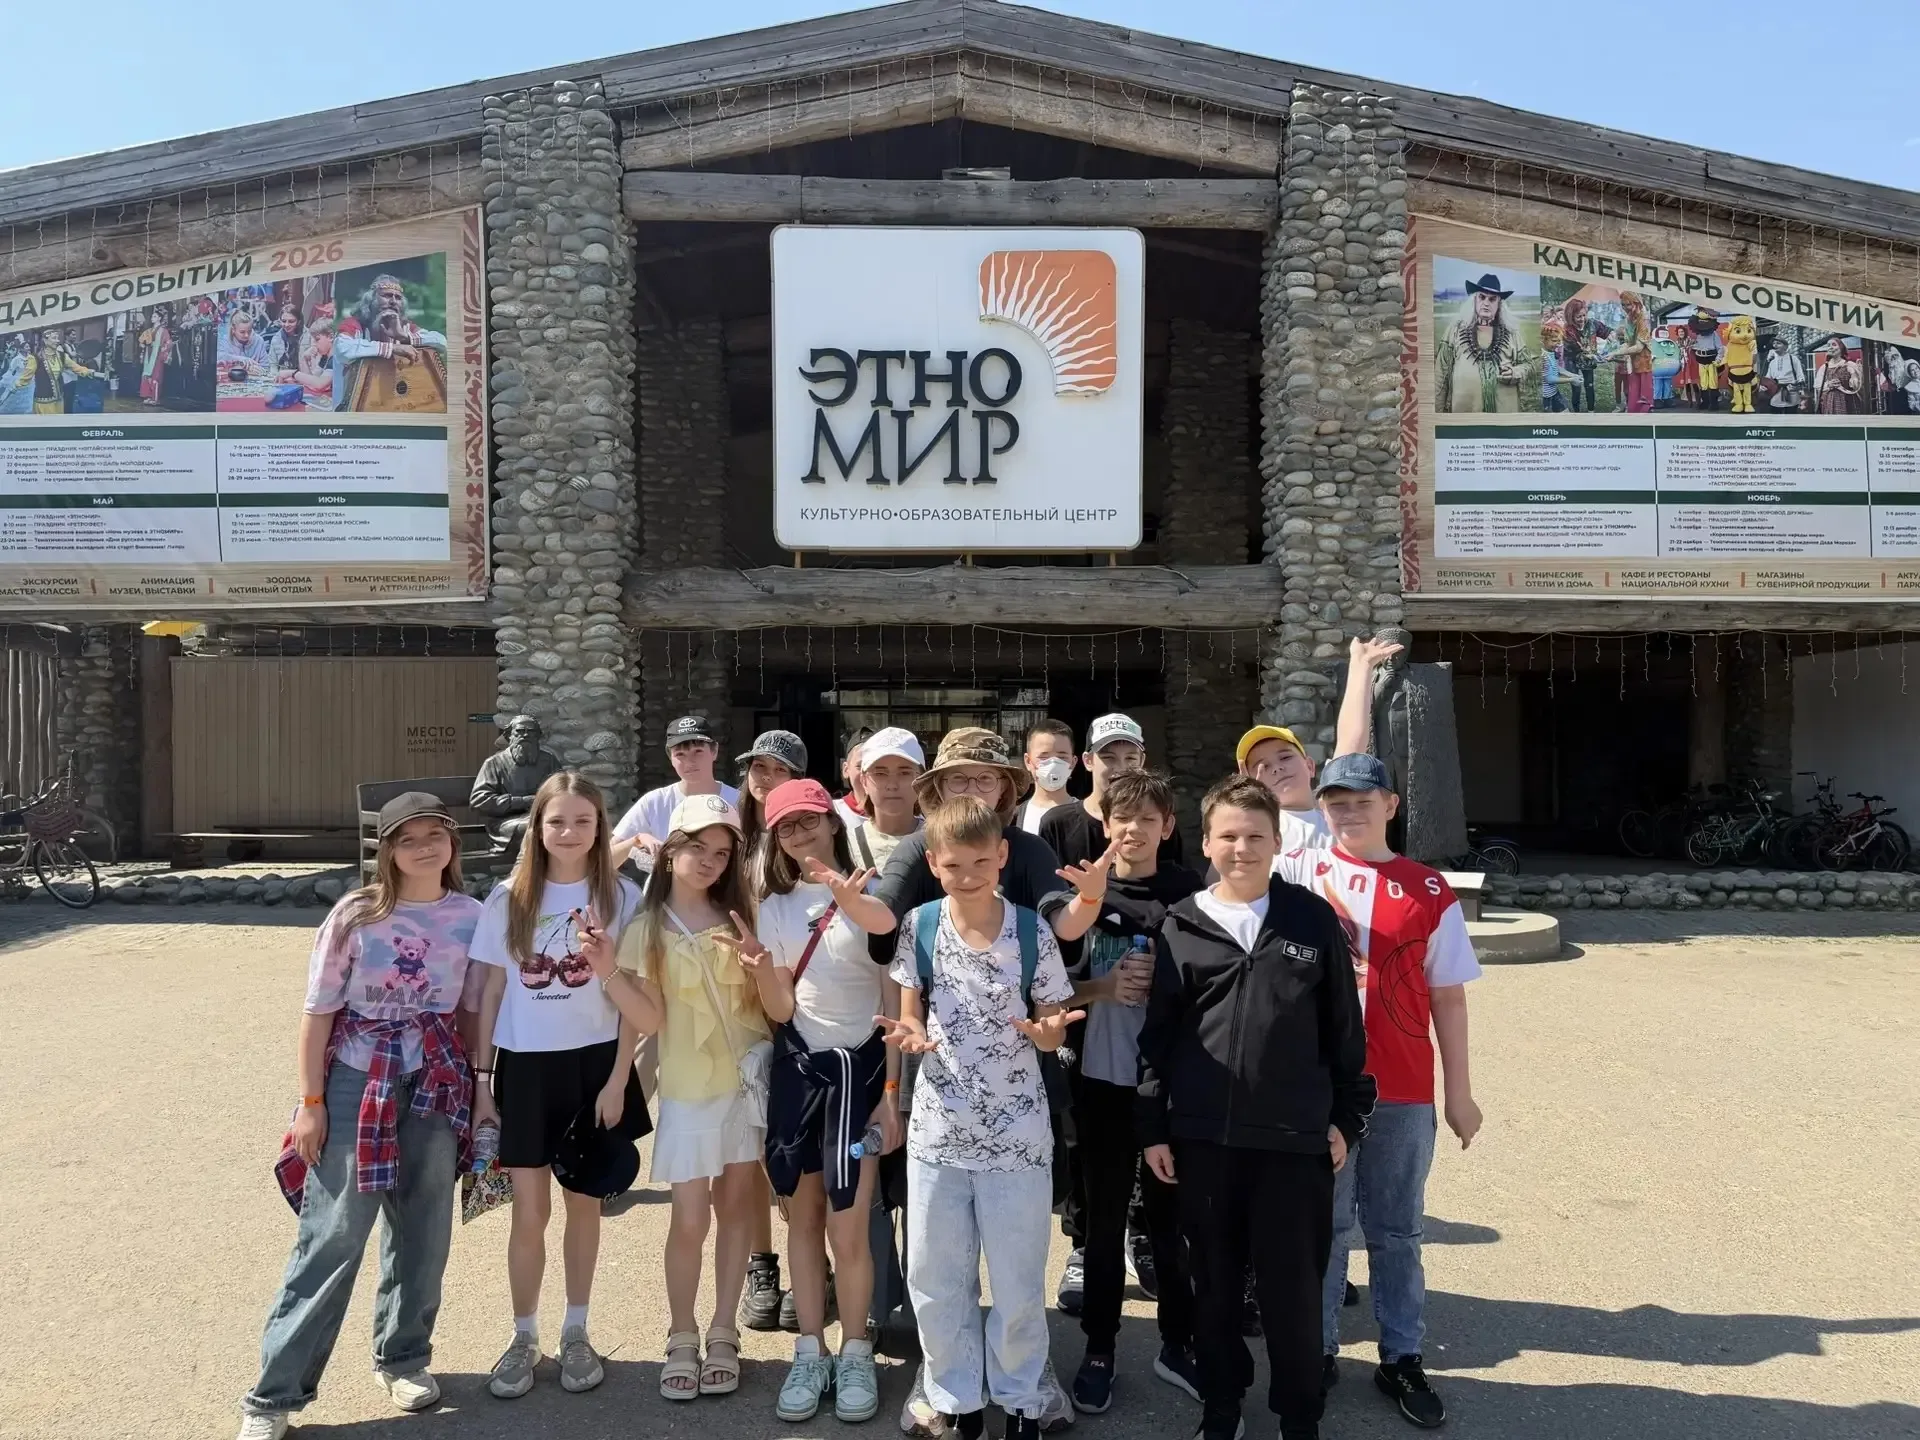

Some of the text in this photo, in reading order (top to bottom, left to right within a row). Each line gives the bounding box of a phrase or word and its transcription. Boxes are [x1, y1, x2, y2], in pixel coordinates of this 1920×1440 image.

[90, 253, 252, 306] СОБЫТИЙ
[270, 240, 344, 272] 2026
[1533, 243, 1920, 337] КАЛЕНДАРЬ СОБЫТИЙ 2
[798, 347, 1023, 408] ЭТНО
[319, 428, 344, 436] МАРТ
[1532, 428, 1559, 436] ИЮЛЬ
[1746, 429, 1776, 437] АВГУСТ
[800, 408, 1020, 486] МИР
[93, 497, 114, 505] МАЙ
[1747, 494, 1781, 502] НОЯБРЬ
[1064, 508, 1117, 523] ЦЕНТР
[1524, 571, 1583, 579] ЭТНИЧЕСКИЕ
[1621, 571, 1644, 579] КАФЕ
[141, 578, 195, 586] АНИМАЦИЯ
[266, 577, 312, 585] ЗООДОМА
[1437, 579, 1493, 587] БАНИ И СПА
[1621, 580, 1696, 588] НАЦИОНАЛЬНОЙ
[1756, 580, 1870, 589] СУВЕНИРНОЙ ПРОДУКЦИИ
[227, 585, 313, 594] АКТИВНЫЙ ОТДЫХ
[407, 726, 456, 737] МЕСТО
[532, 992, 572, 1000] Sweetest
